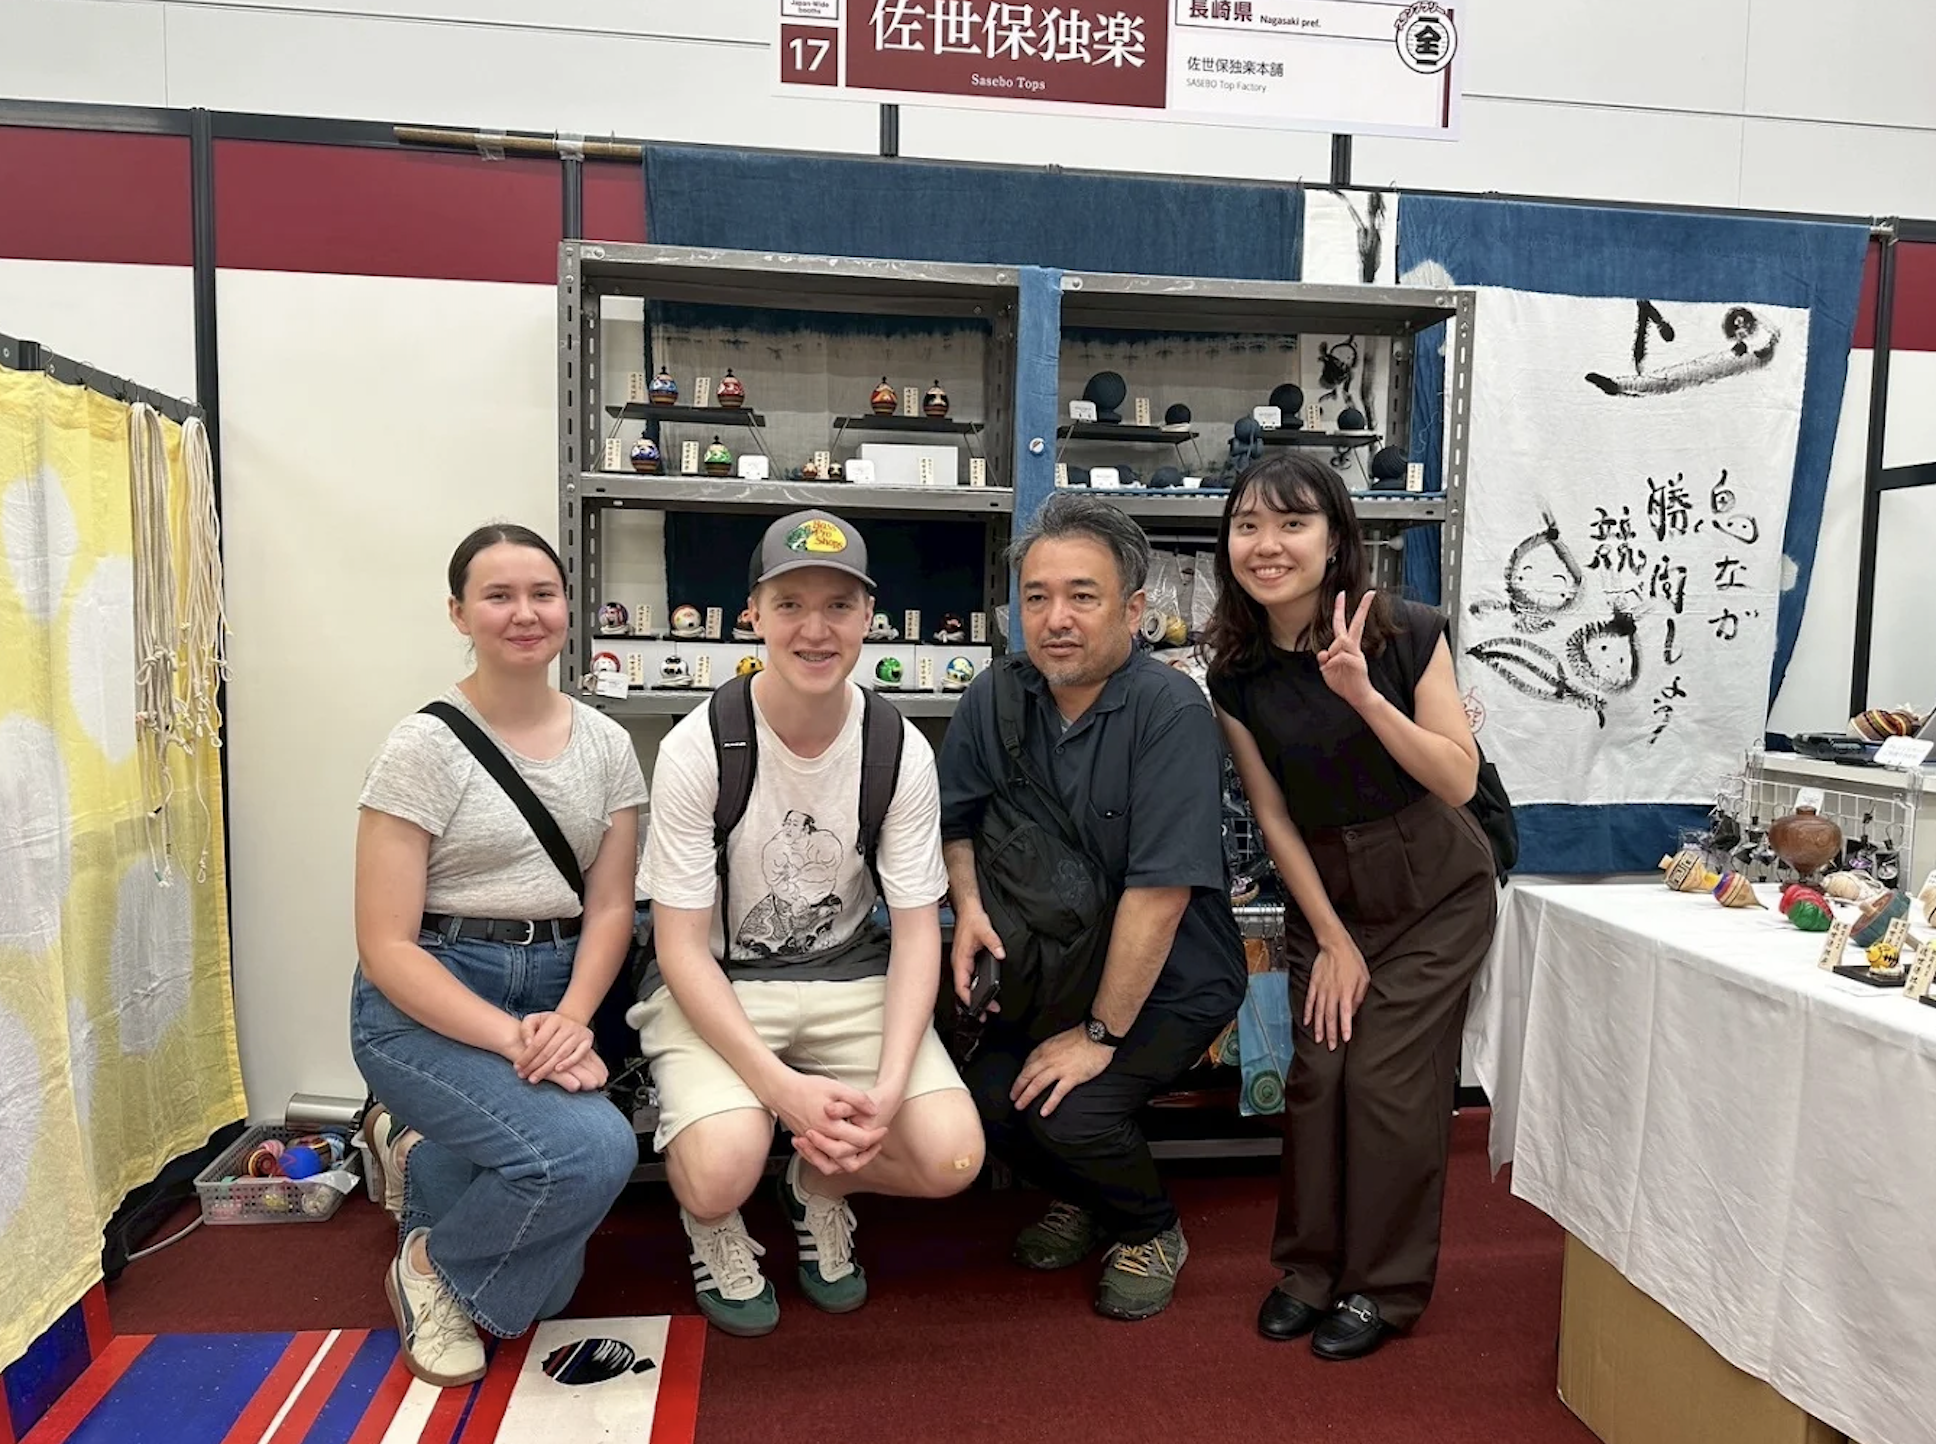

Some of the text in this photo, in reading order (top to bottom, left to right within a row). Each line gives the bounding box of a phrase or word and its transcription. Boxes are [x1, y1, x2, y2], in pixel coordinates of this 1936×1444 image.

[1189, 0, 1253, 22] 長崎県
[1259, 15, 1322, 28] Nagasaki pref.
[868, 0, 1146, 68] 佐世保独楽
[1414, 25, 1441, 55] 全
[789, 38, 830, 71] 17
[971, 73, 1046, 91] Sasebo Tops
[1186, 78, 1267, 93] SASEBO Top Factory
[812, 529, 832, 538] Pro
[813, 520, 838, 532] Bass
[815, 537, 843, 549] Shops
